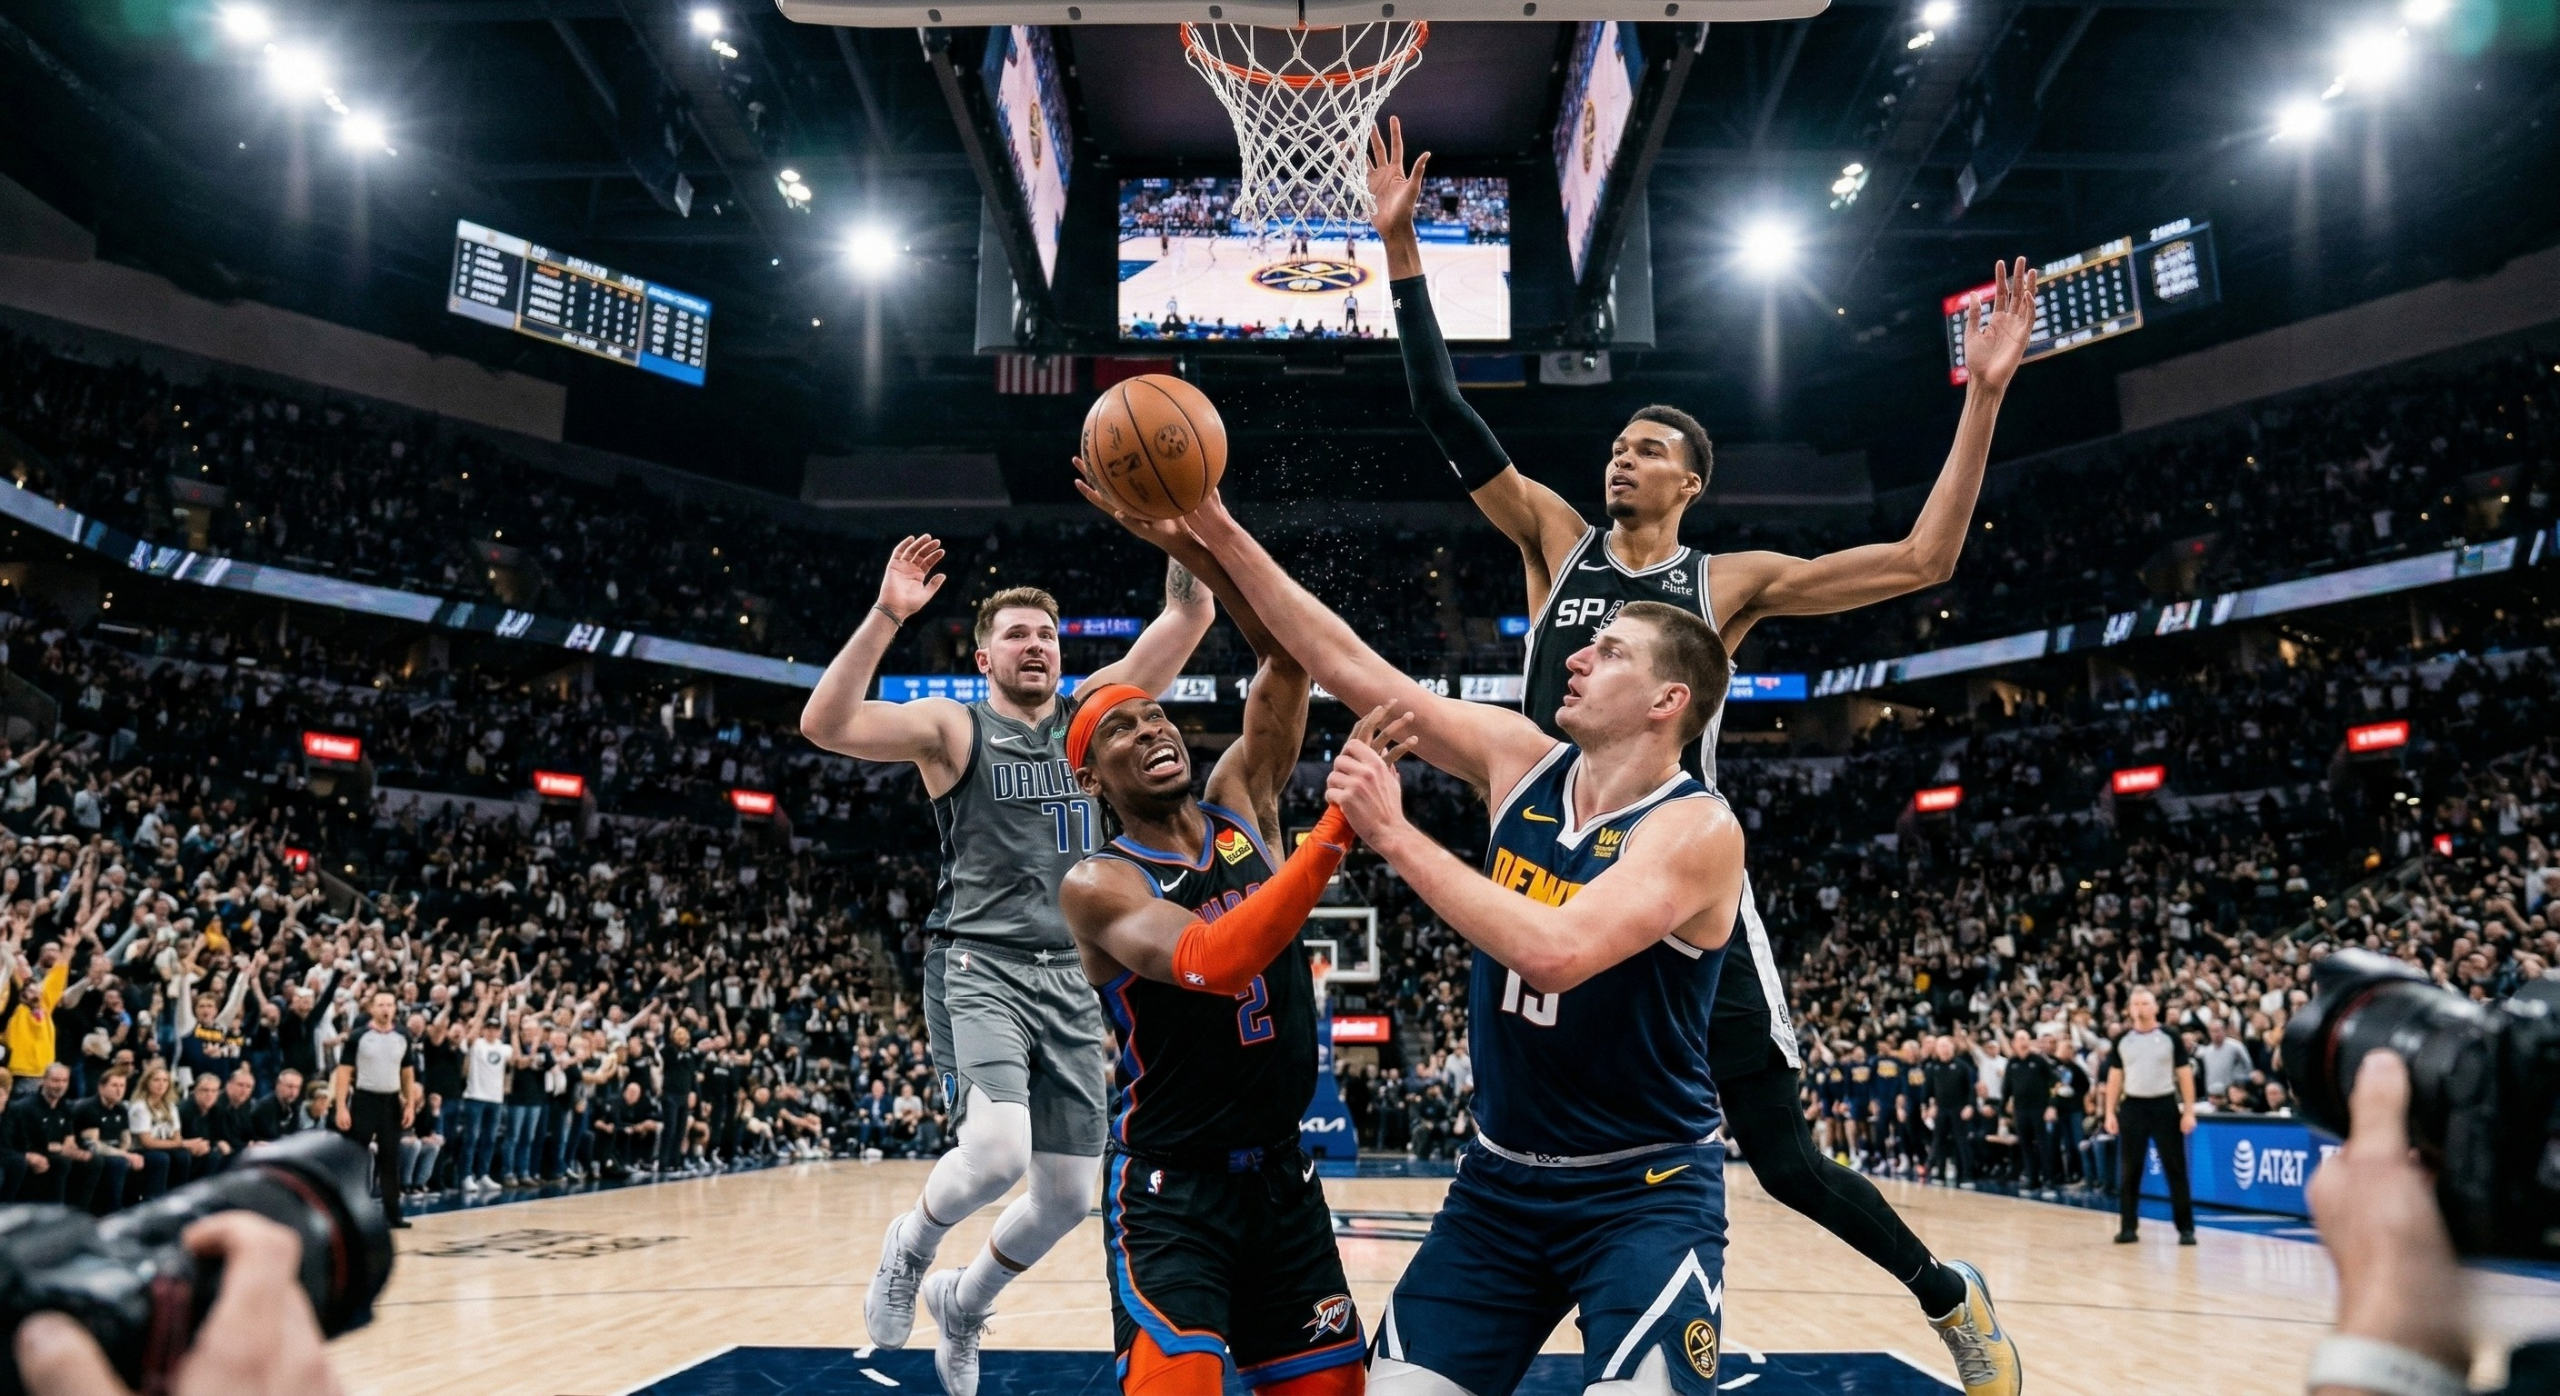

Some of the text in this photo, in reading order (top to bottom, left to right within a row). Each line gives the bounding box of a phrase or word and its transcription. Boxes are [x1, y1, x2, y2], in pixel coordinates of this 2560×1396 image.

[1555, 598, 1624, 628] SP
[992, 759, 1081, 800] DALLA
[1041, 800, 1091, 853] 77
[1235, 974, 1275, 1045] 2
[2257, 1148, 2308, 1187] AT&T
